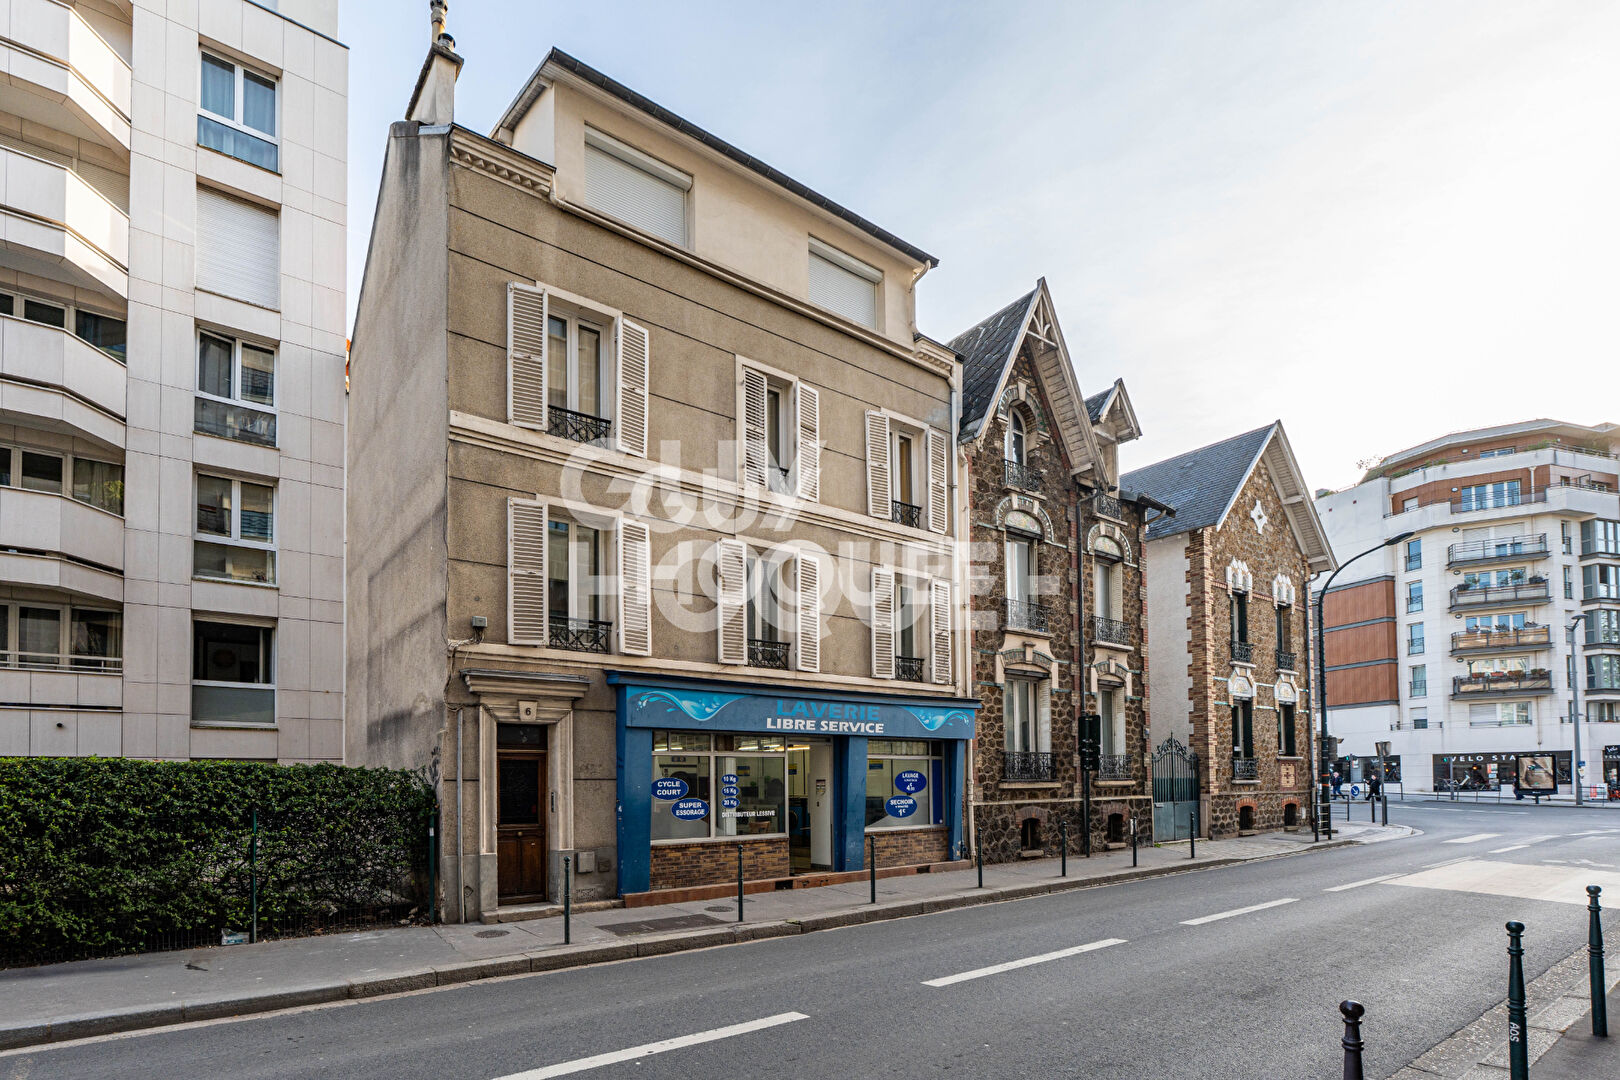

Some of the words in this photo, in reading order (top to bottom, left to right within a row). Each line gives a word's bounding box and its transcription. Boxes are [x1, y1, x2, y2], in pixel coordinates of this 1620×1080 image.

[525, 707, 532, 716] 6
[776, 699, 881, 721] LAVERIE
[766, 717, 816, 731] LIBRE
[820, 720, 884, 733] SERVICE
